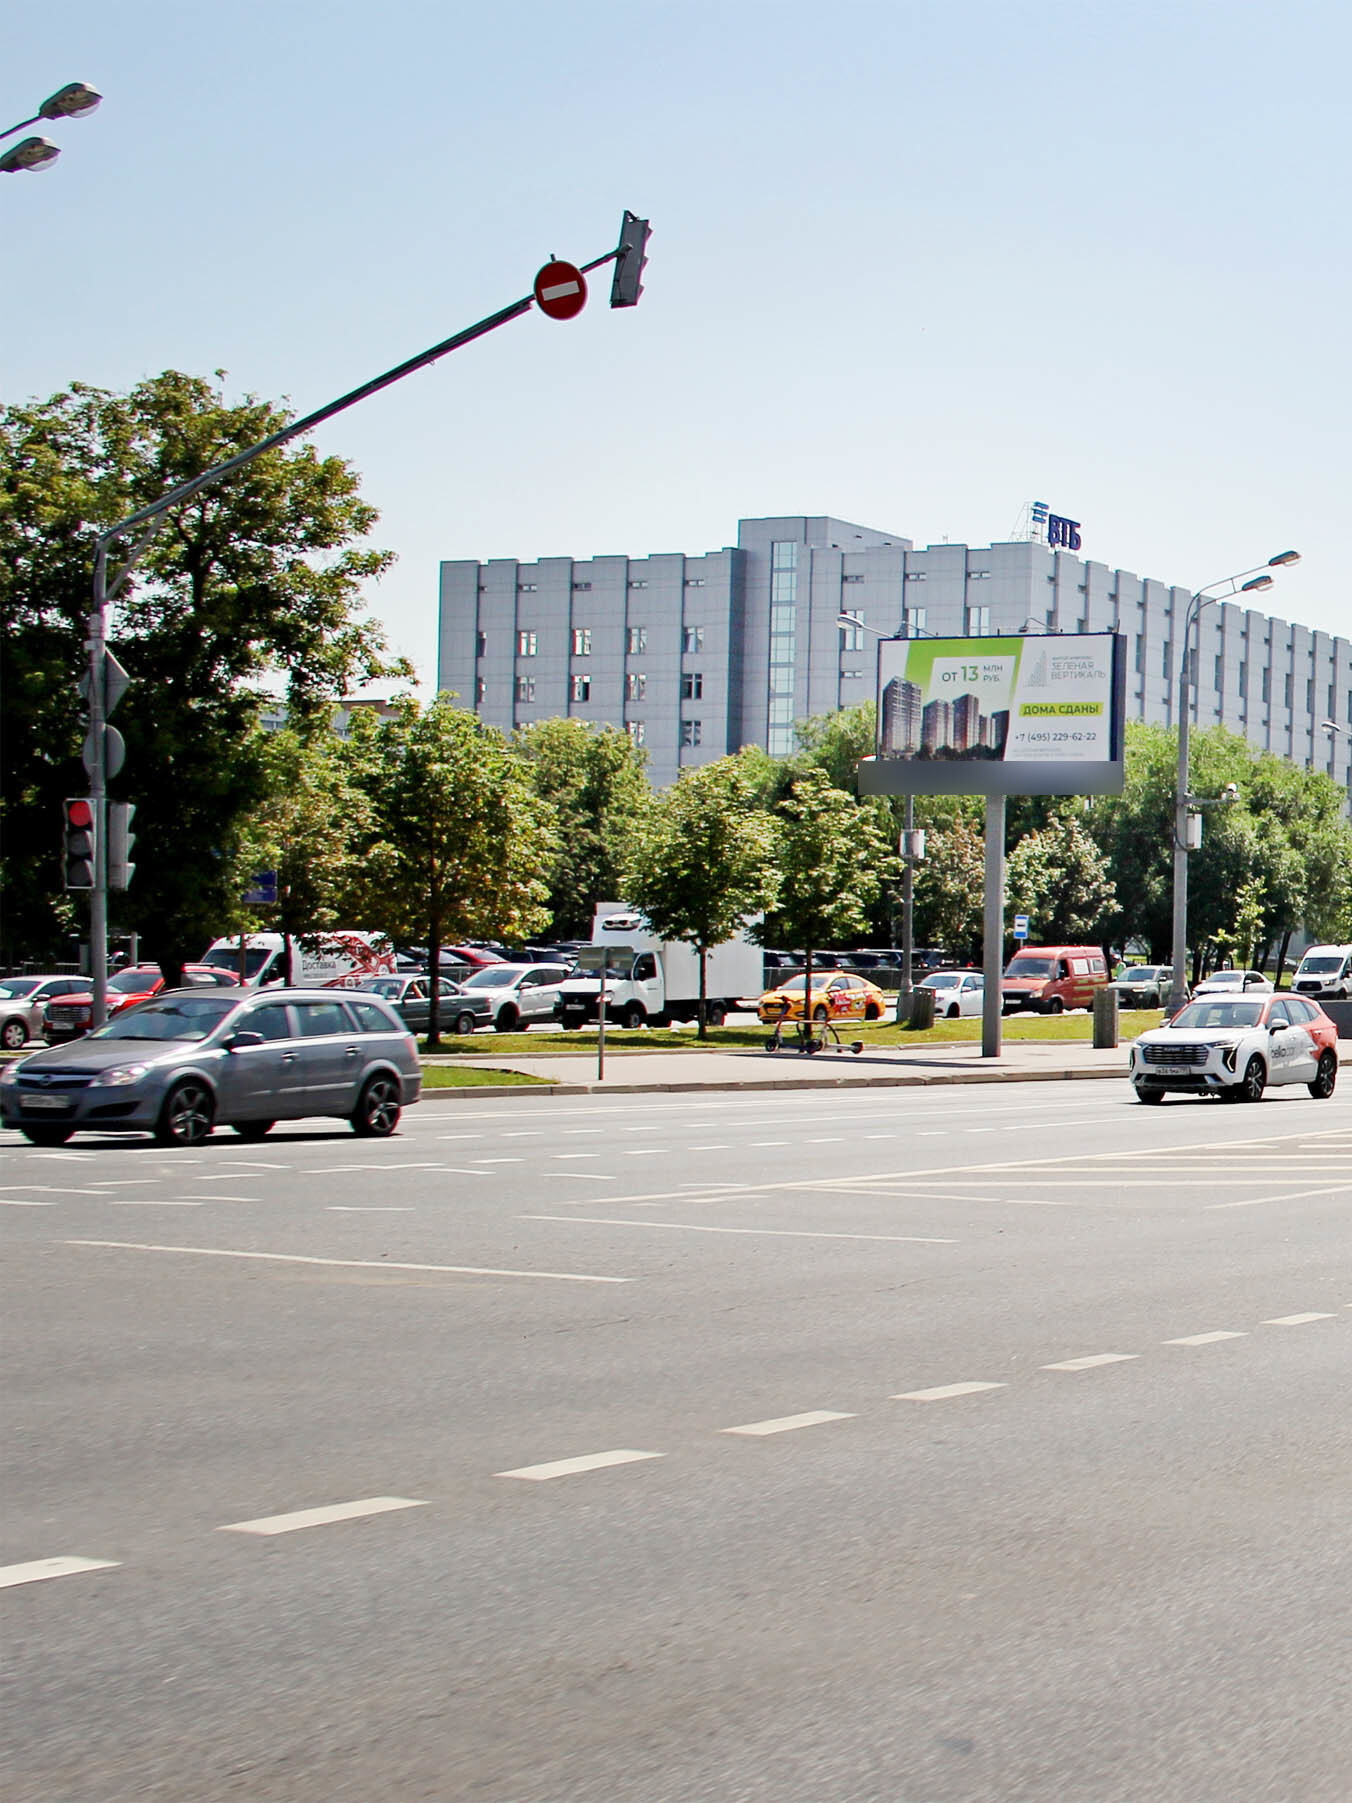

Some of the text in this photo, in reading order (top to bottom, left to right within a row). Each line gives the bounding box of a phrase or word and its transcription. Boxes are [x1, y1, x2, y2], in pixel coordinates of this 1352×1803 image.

[1048, 514, 1081, 550] ВТБ
[961, 665, 979, 681] 13
[1023, 704, 1099, 715] ДОМА СДАНЫ
[1027, 732, 1051, 743] (495)
[1052, 731, 1097, 742] 229-62-22
